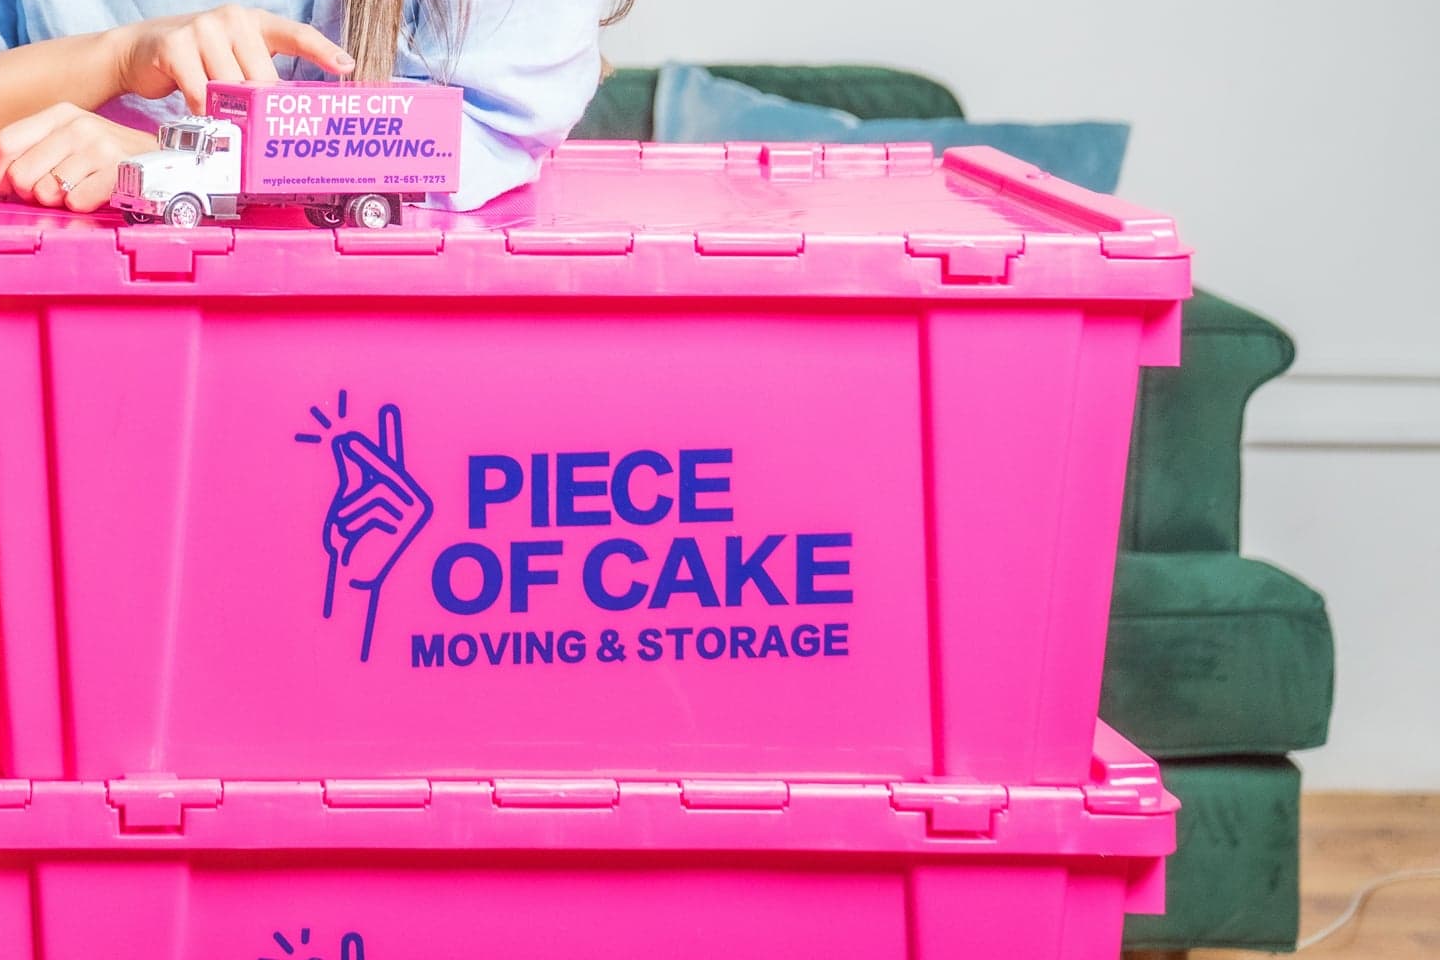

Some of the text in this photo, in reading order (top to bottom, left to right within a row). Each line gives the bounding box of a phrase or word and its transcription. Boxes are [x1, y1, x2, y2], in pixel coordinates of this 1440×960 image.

[265, 94, 312, 114] FOR
[317, 95, 360, 114] THE
[366, 95, 414, 115] CITY
[265, 116, 403, 137] THAT NEVER
[263, 139, 452, 158] STOPS MOVING...
[263, 175, 447, 187] mypieceofcakemove.com 212-651-7273
[468, 448, 734, 530] PIECE
[431, 532, 854, 616] OF CAKE
[411, 623, 850, 668] MOVING & STORAGE
